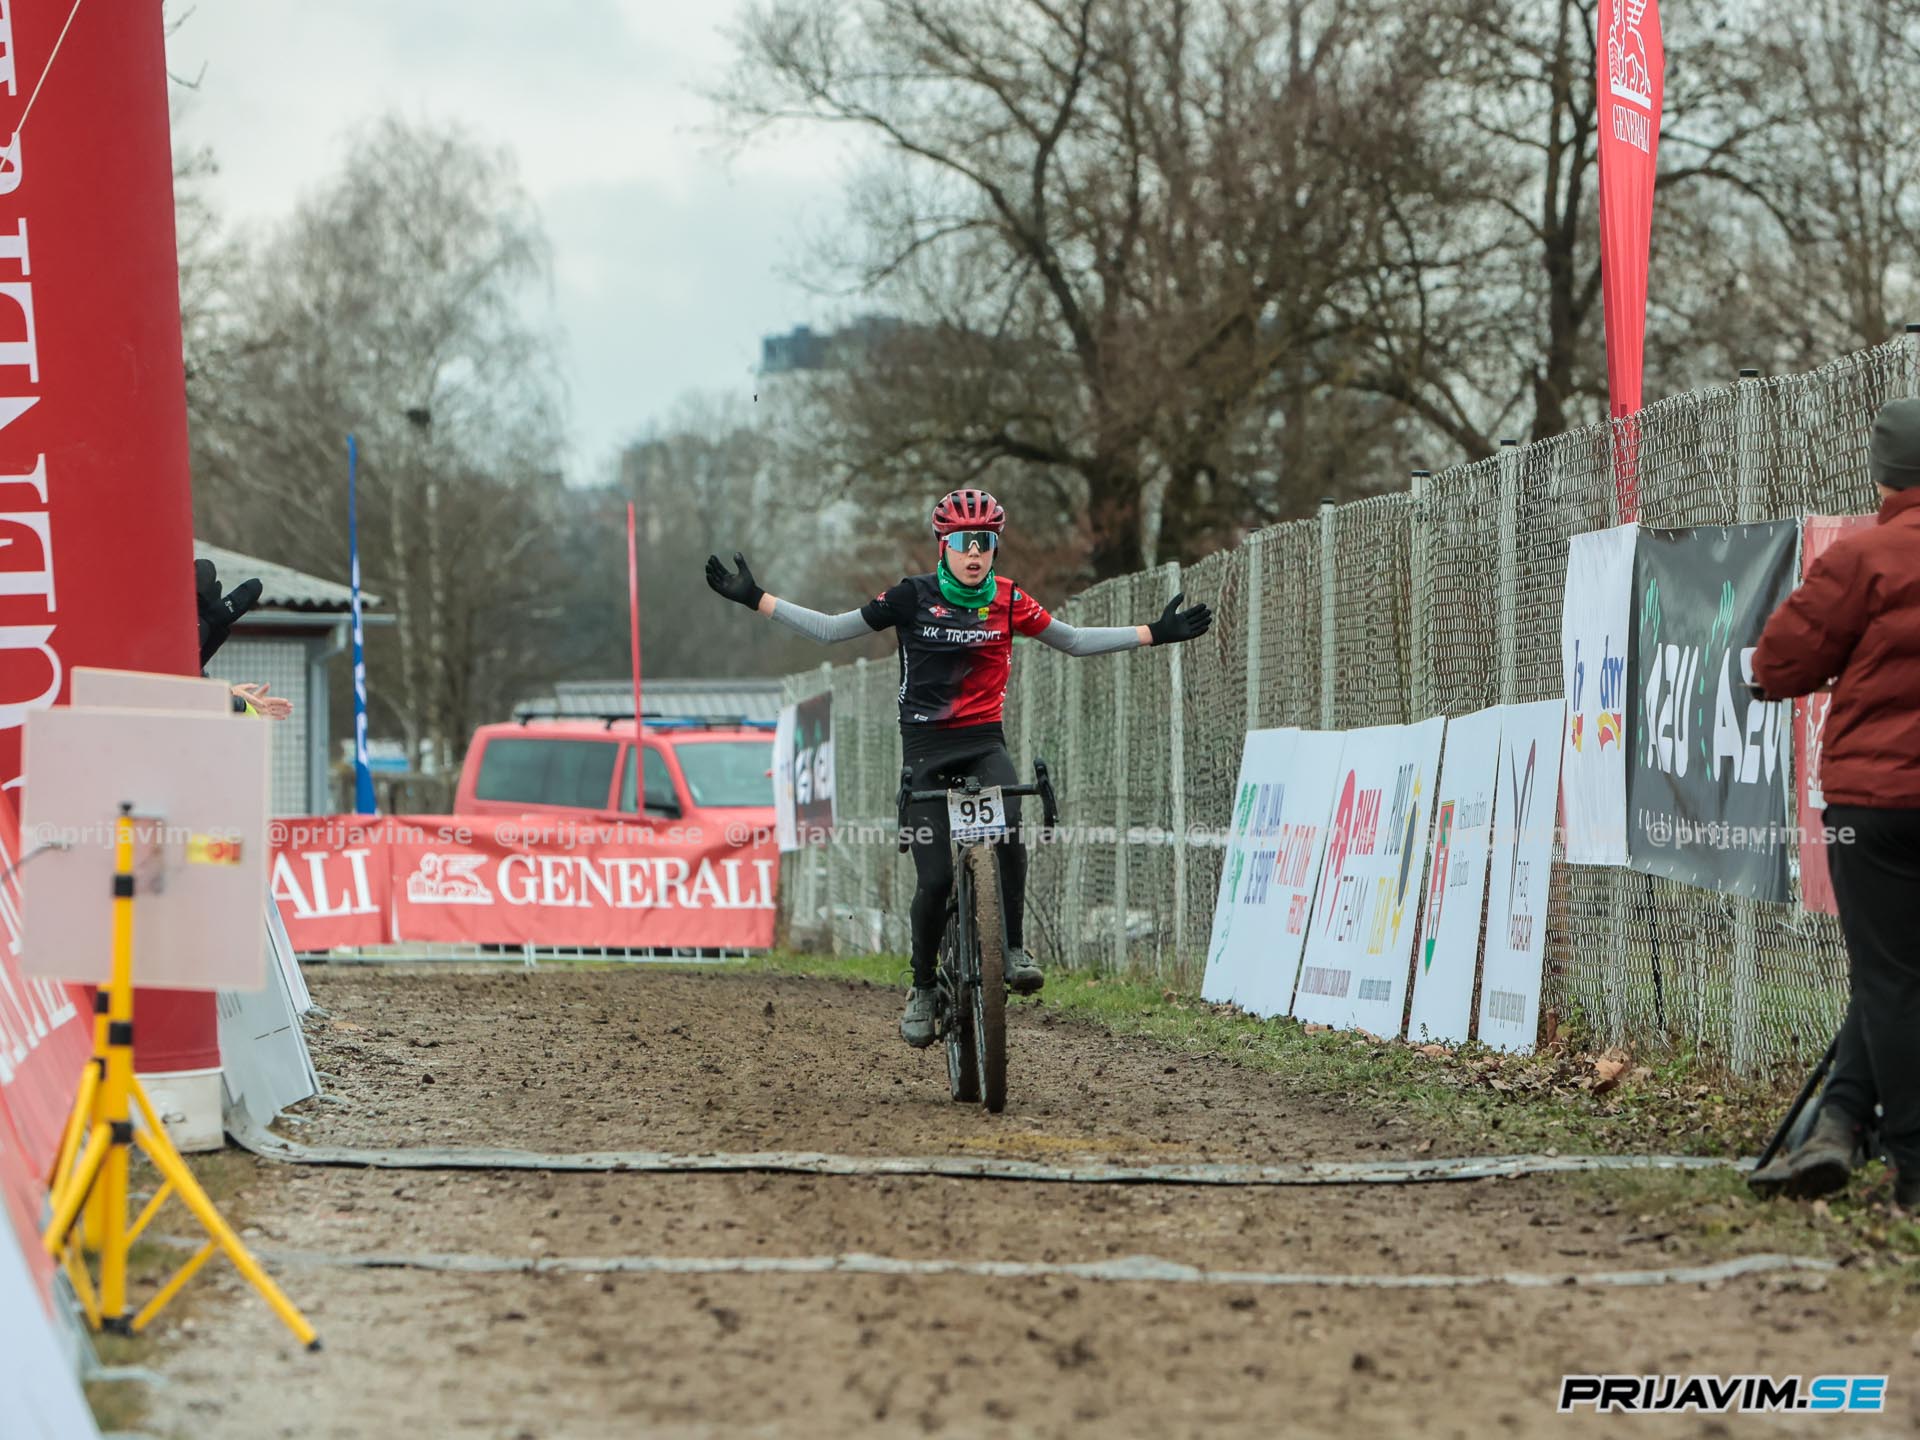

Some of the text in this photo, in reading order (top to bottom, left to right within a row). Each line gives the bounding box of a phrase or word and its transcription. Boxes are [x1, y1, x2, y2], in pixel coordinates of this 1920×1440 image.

[1612, 104, 1651, 154] GENERALI
[922, 626, 940, 640] KK
[960, 798, 995, 825] 95
[1348, 788, 1382, 855] PIKA
[497, 854, 776, 909] GENERALI
[1334, 876, 1370, 942] TEAM
